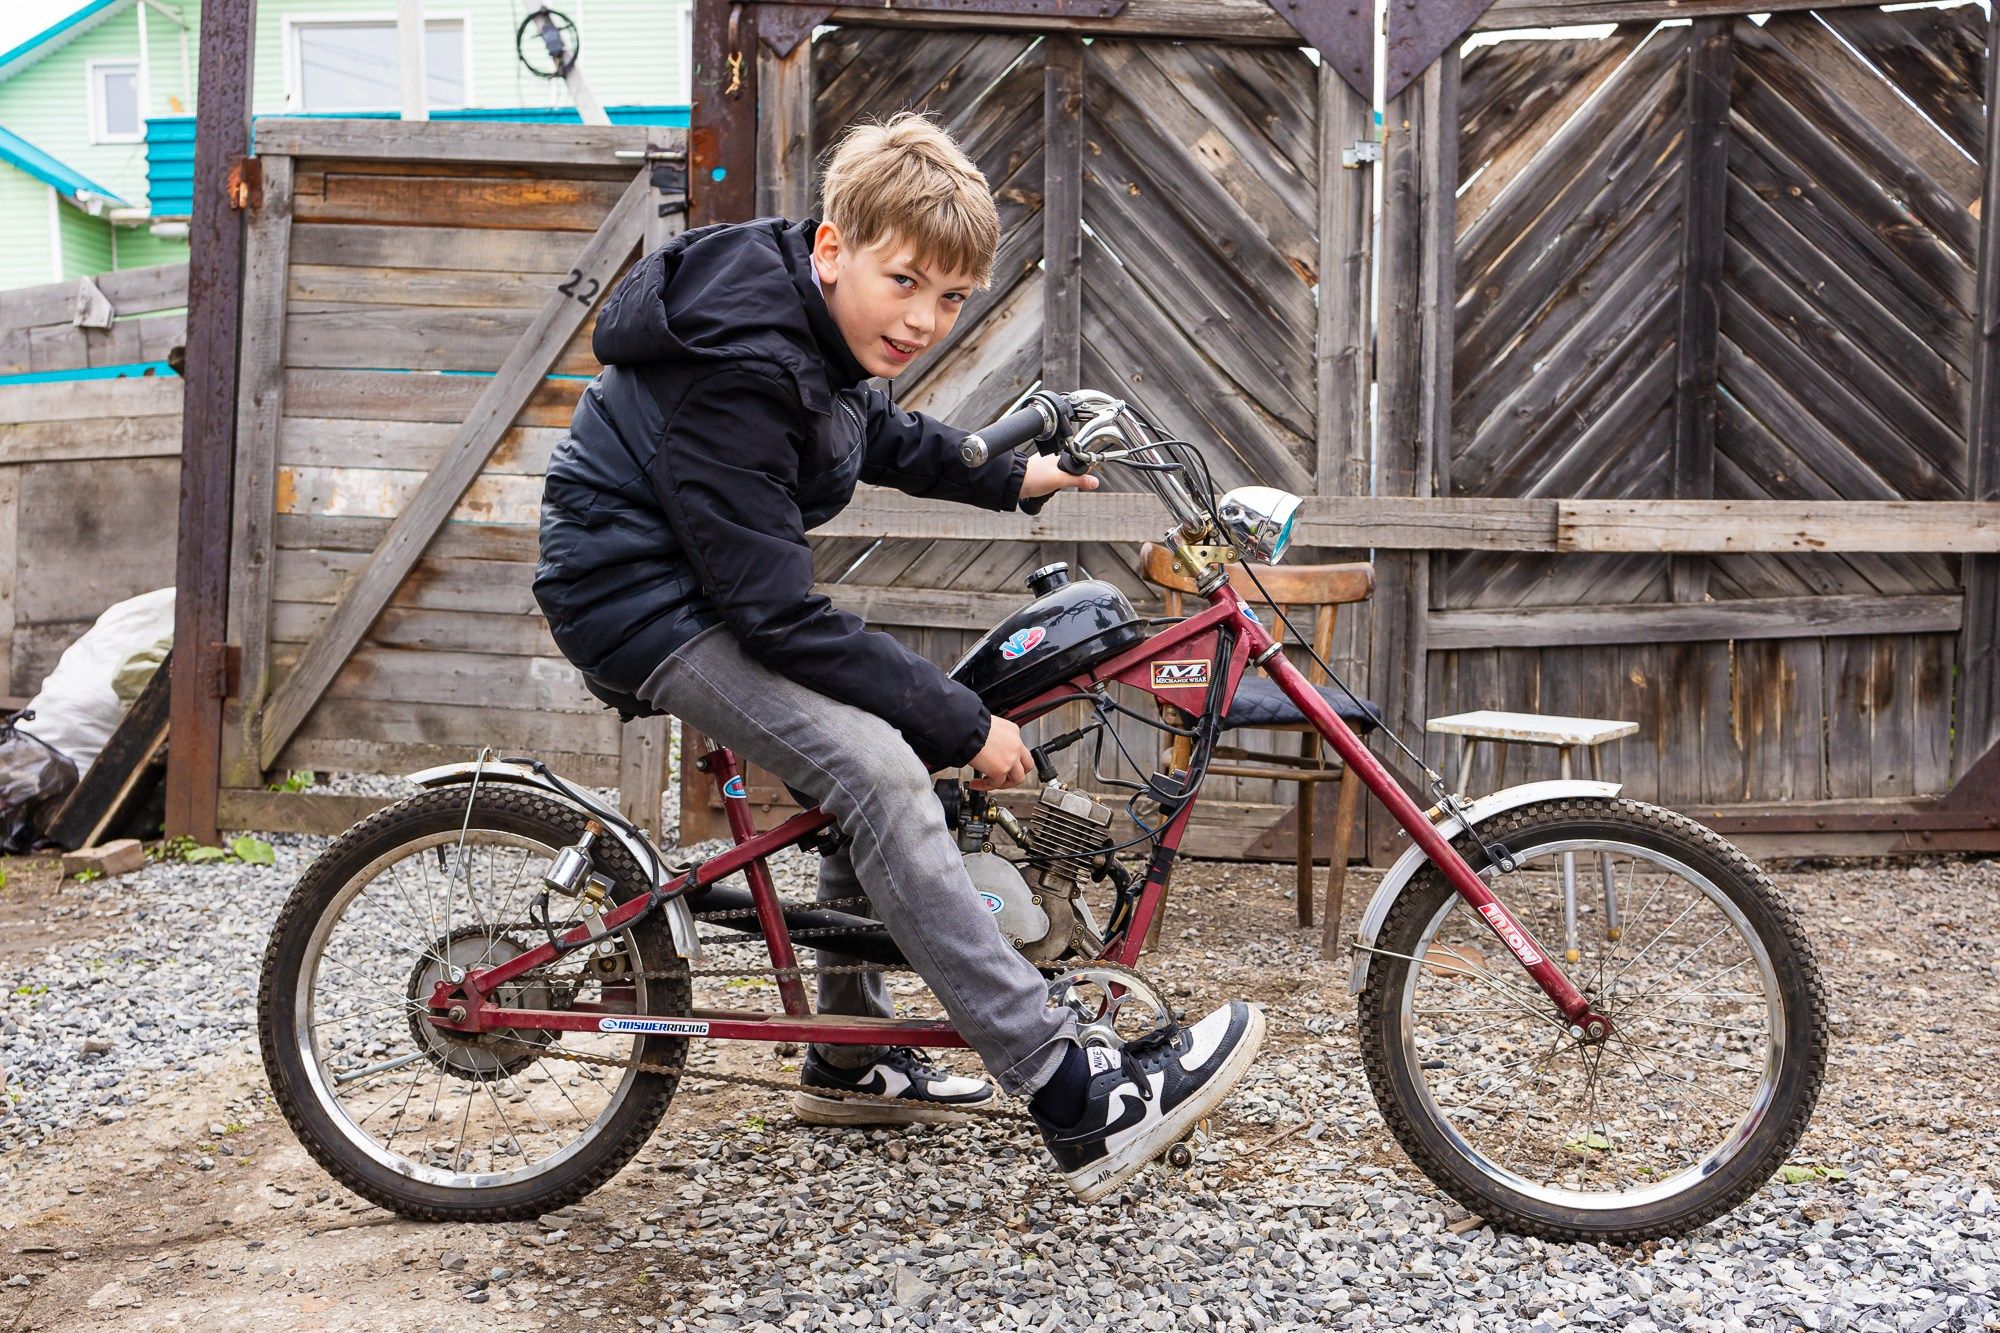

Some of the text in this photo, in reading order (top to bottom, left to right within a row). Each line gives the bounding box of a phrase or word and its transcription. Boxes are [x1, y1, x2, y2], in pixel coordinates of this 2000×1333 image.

[557, 268, 600, 307] 22
[1003, 629, 1030, 655] VP
[1156, 664, 1206, 678] M
[1485, 905, 1536, 963] MOTUL
[1093, 1050, 1103, 1069] NIKE
[1098, 1169, 1114, 1184] AIR
